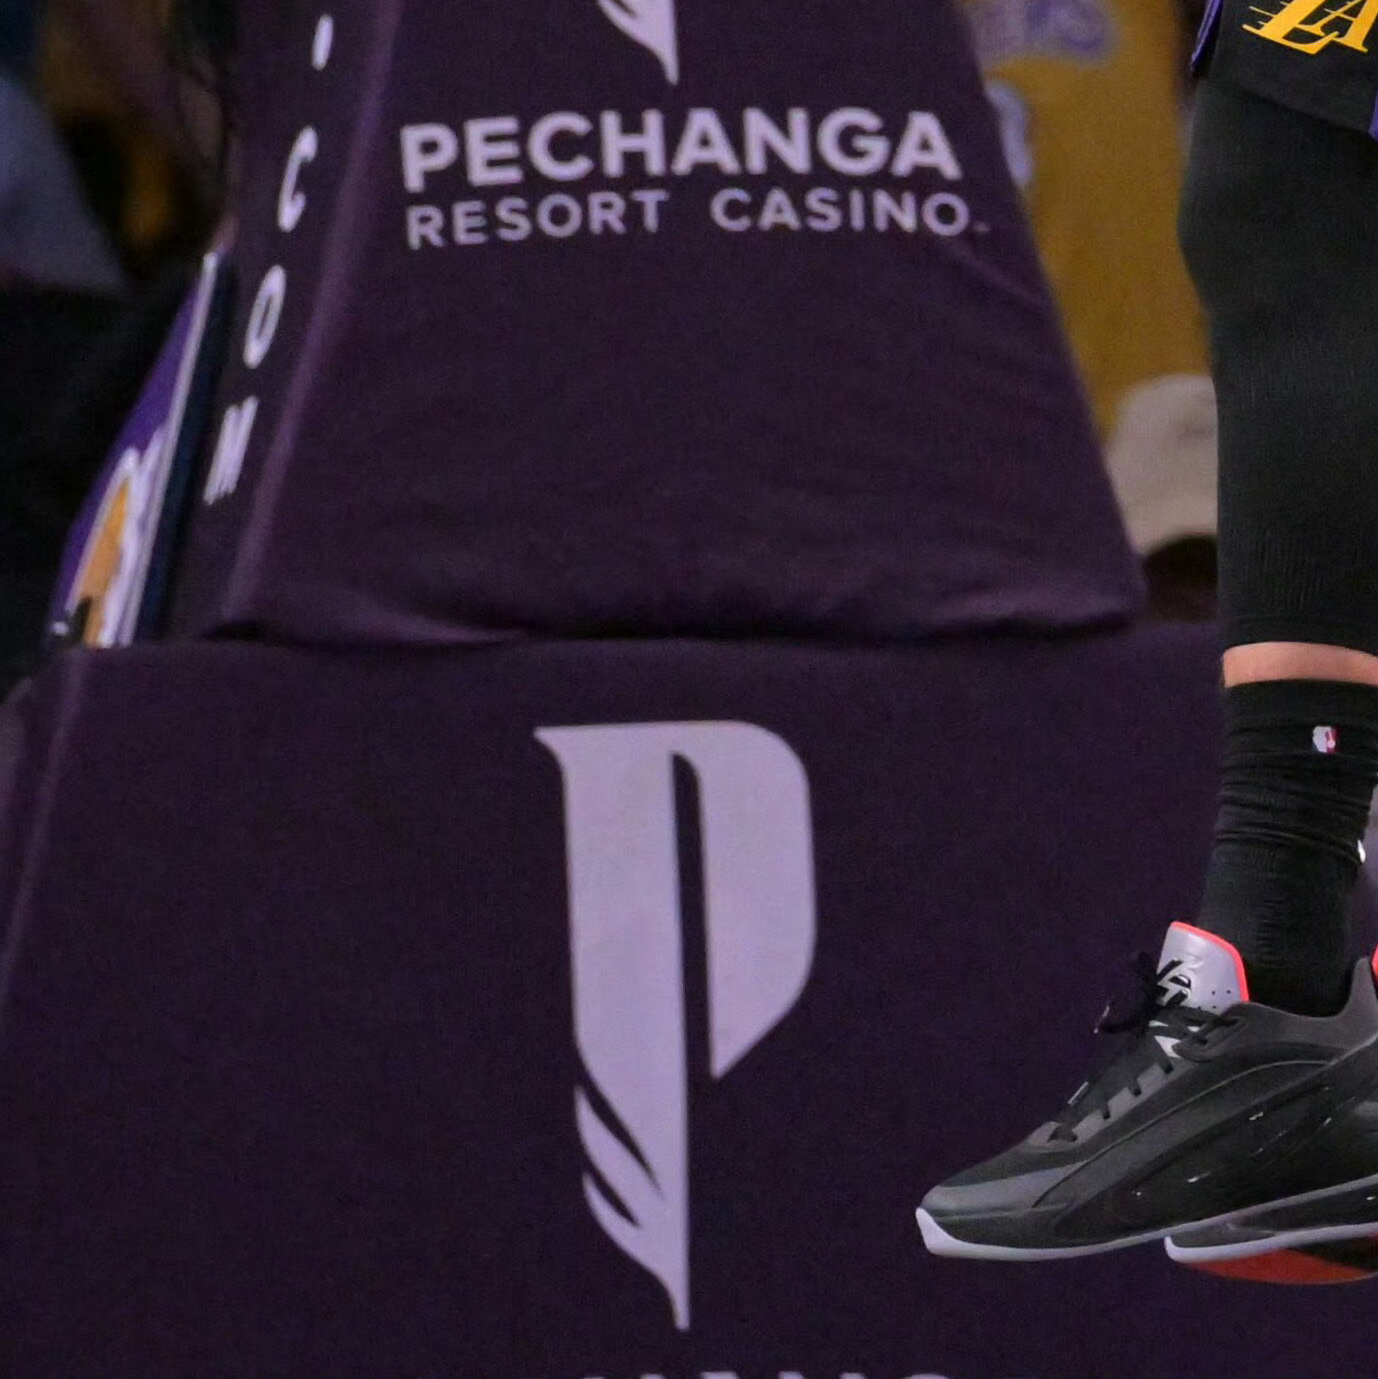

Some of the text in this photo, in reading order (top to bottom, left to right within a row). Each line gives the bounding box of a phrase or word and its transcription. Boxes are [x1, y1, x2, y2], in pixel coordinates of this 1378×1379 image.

[400, 106, 963, 194] PECHANGA
[406, 187, 970, 250] RESORT CASINO
